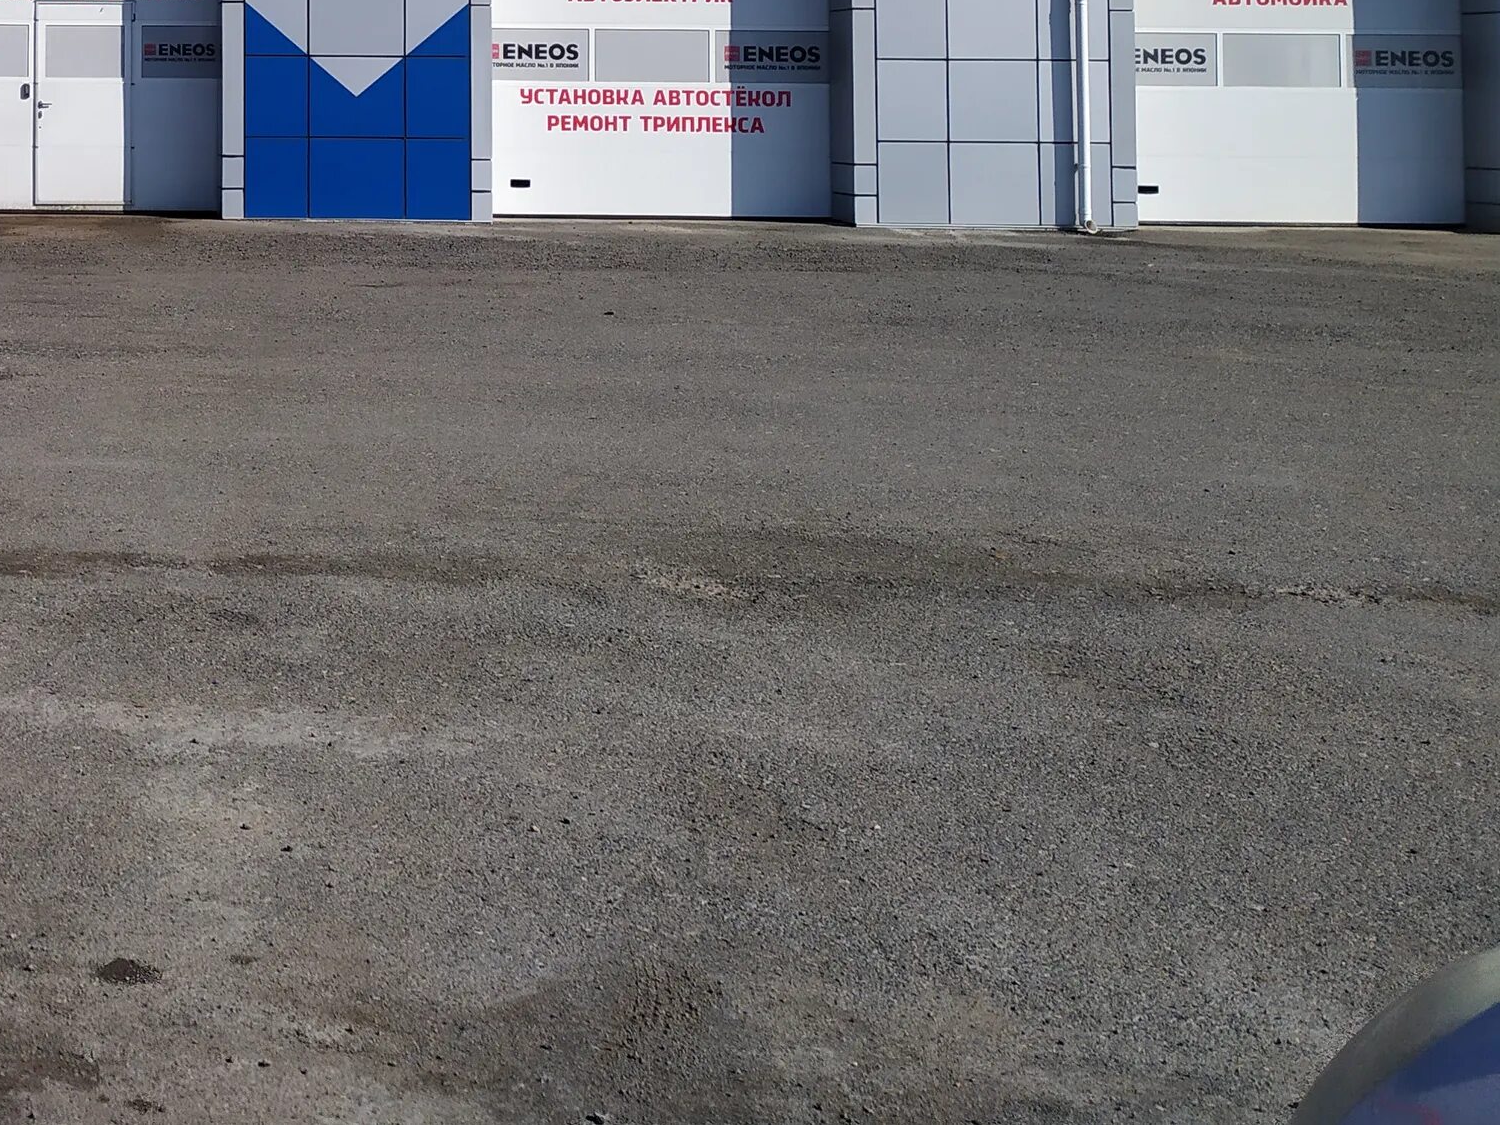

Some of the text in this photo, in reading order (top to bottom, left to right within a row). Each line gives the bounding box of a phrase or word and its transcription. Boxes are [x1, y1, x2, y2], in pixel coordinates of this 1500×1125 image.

[158, 43, 216, 56] ENEOS
[503, 43, 579, 60] ENEOS
[743, 45, 821, 63] ENEOS
[1375, 50, 1454, 67] ENEOS
[519, 86, 792, 107] УСТАНОВКА АВТОСТЁКОЛ
[547, 115, 765, 133] РЕМОНТ ТРИПЛЕКСА
